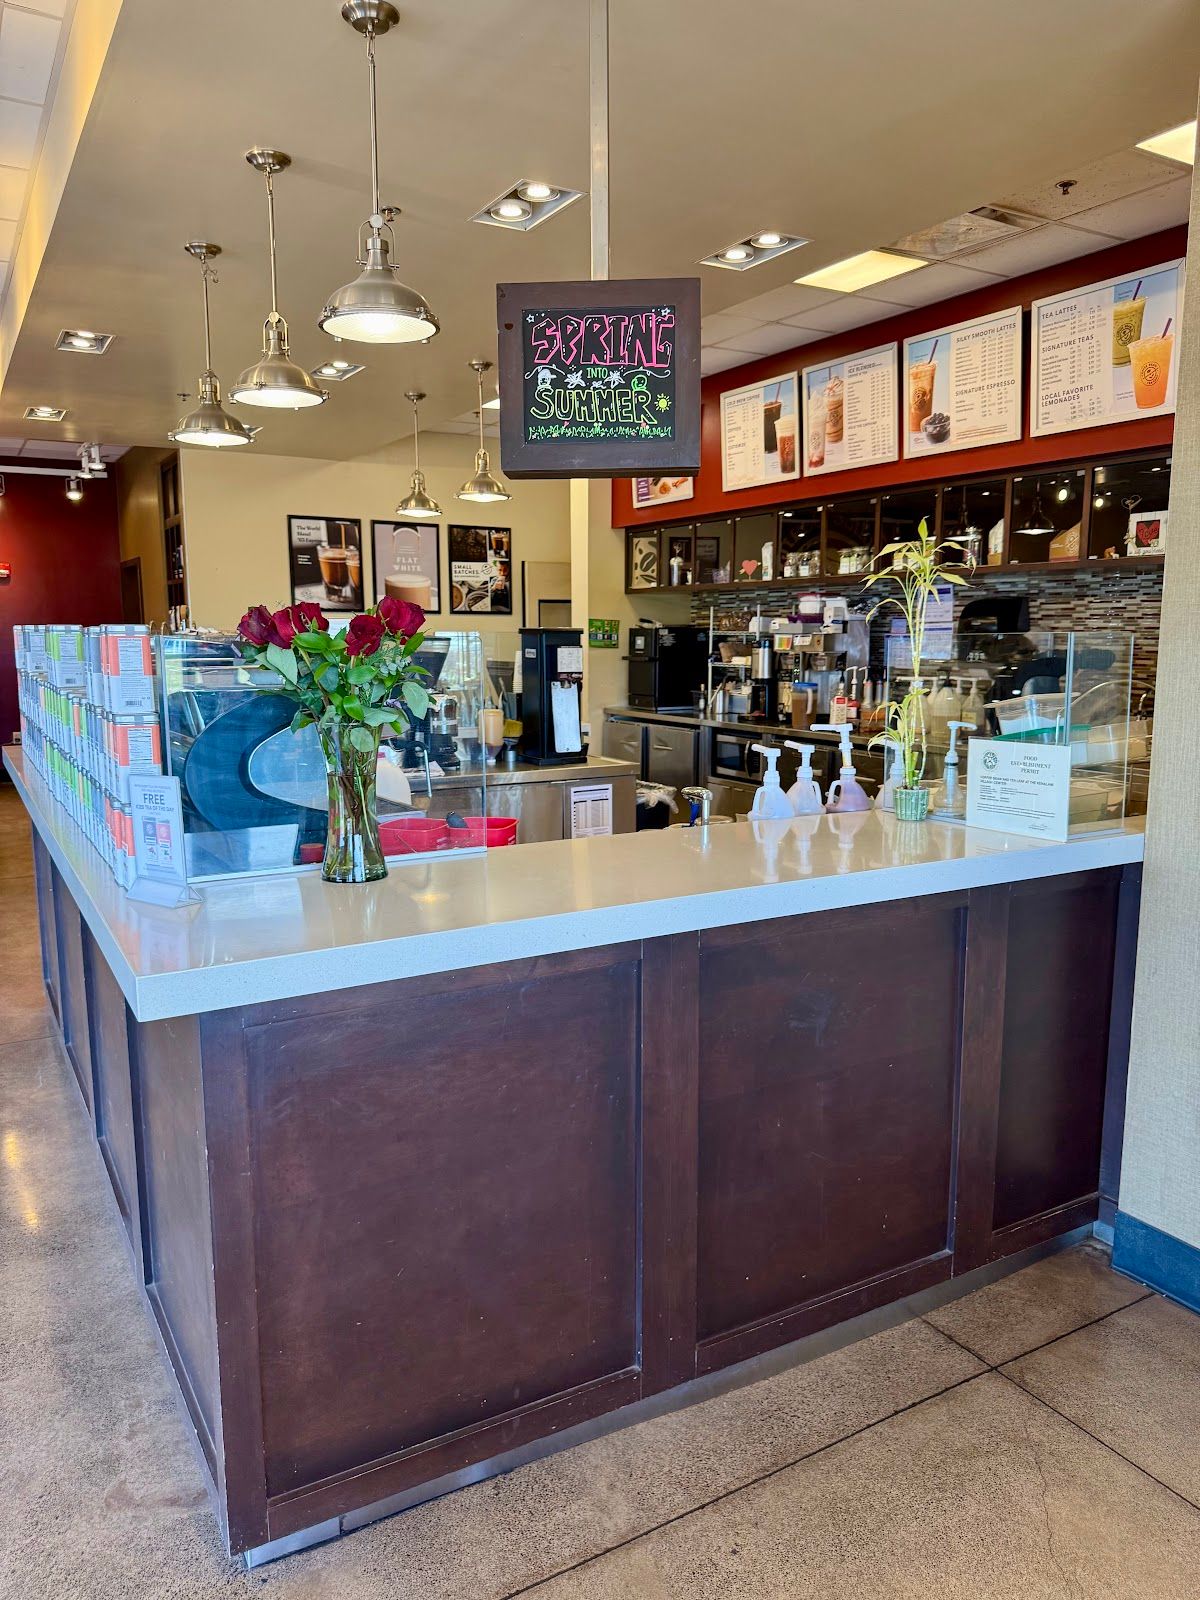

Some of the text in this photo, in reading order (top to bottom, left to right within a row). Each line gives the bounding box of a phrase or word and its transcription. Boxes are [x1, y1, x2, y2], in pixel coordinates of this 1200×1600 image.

[1042, 304, 1078, 320] TEA LATTES
[532, 313, 674, 368] SPRING
[956, 322, 1016, 344] SILKY SMOOTH LATTES
[1041, 334, 1094, 353] SIGNATURE TEAS
[586, 367, 608, 379] INTO
[955, 379, 1016, 397] SIGNATURE ESPRESSO
[1041, 384, 1094, 401] LOCAL FAVORITE
[530, 388, 657, 424] SUMMER
[1041, 393, 1080, 407] LEMONADES
[393, 564, 422, 572] WHITE
[143, 793, 165, 805] FREE
